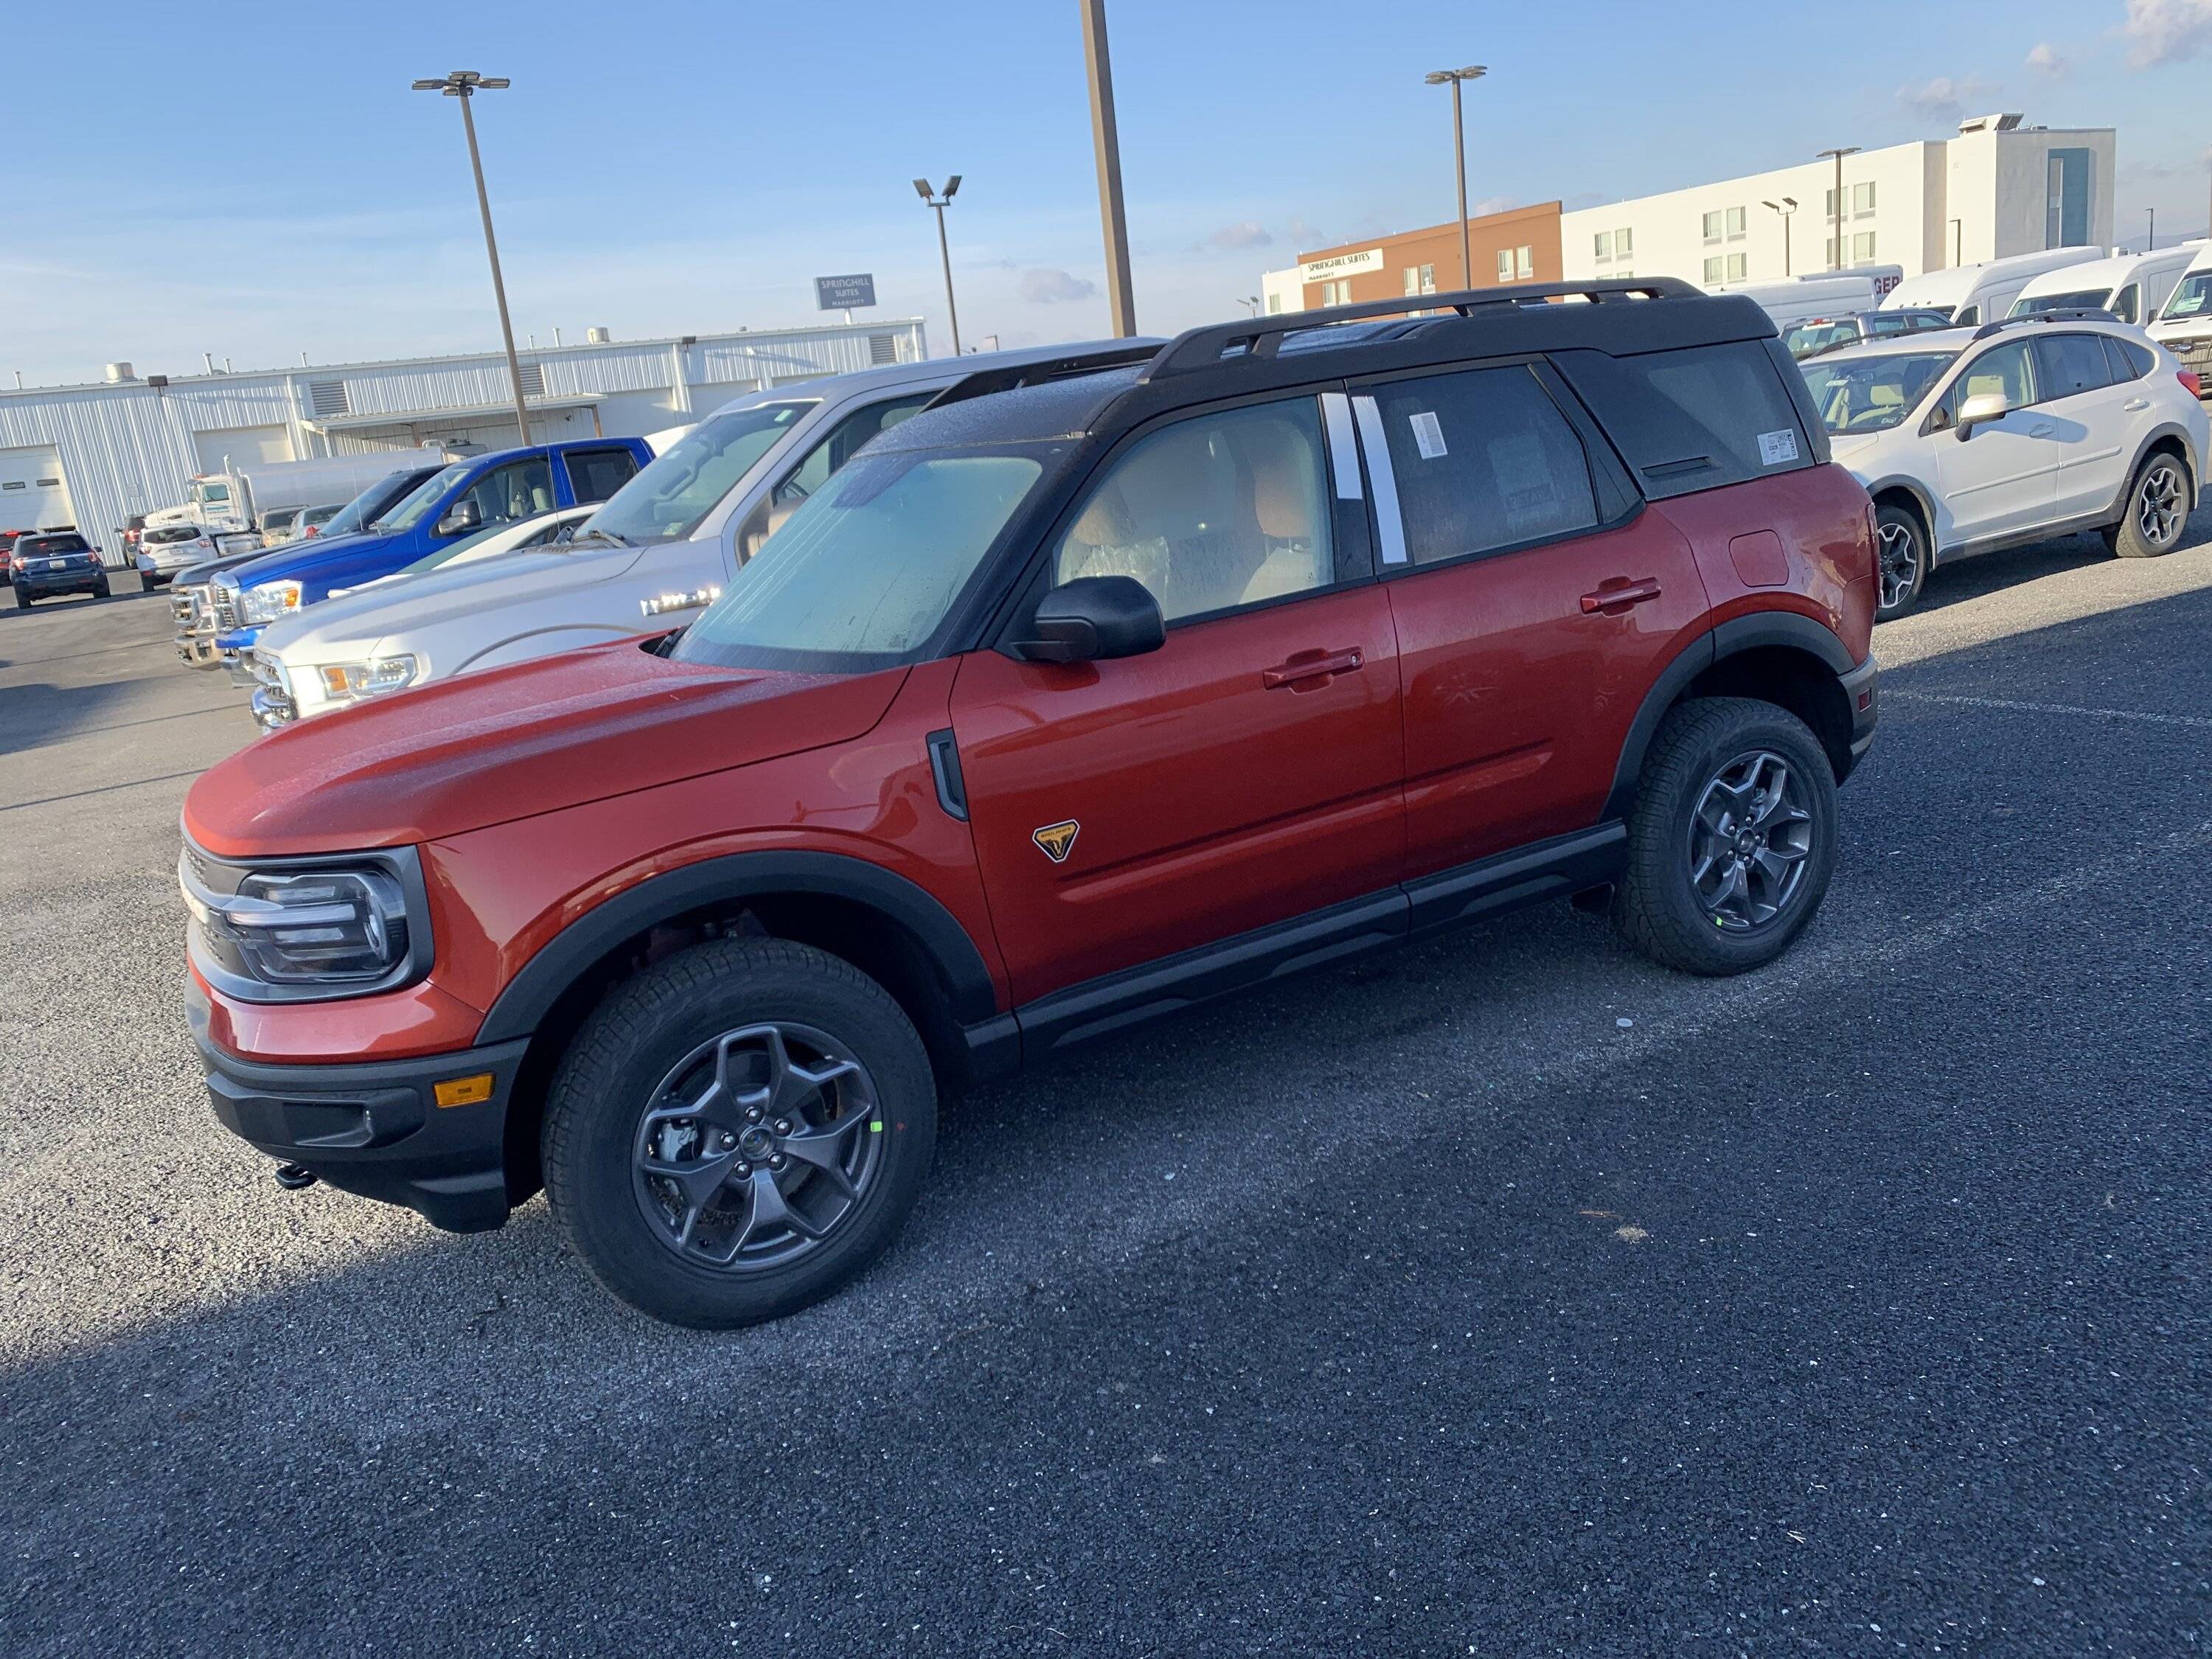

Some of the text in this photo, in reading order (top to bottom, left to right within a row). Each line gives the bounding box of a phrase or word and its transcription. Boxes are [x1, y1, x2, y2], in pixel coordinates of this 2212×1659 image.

[1309, 252, 1370, 271] SPRINGHILL SUITES
[821, 277, 869, 288] SPRINGHILL
[835, 288, 859, 296] SUITES
